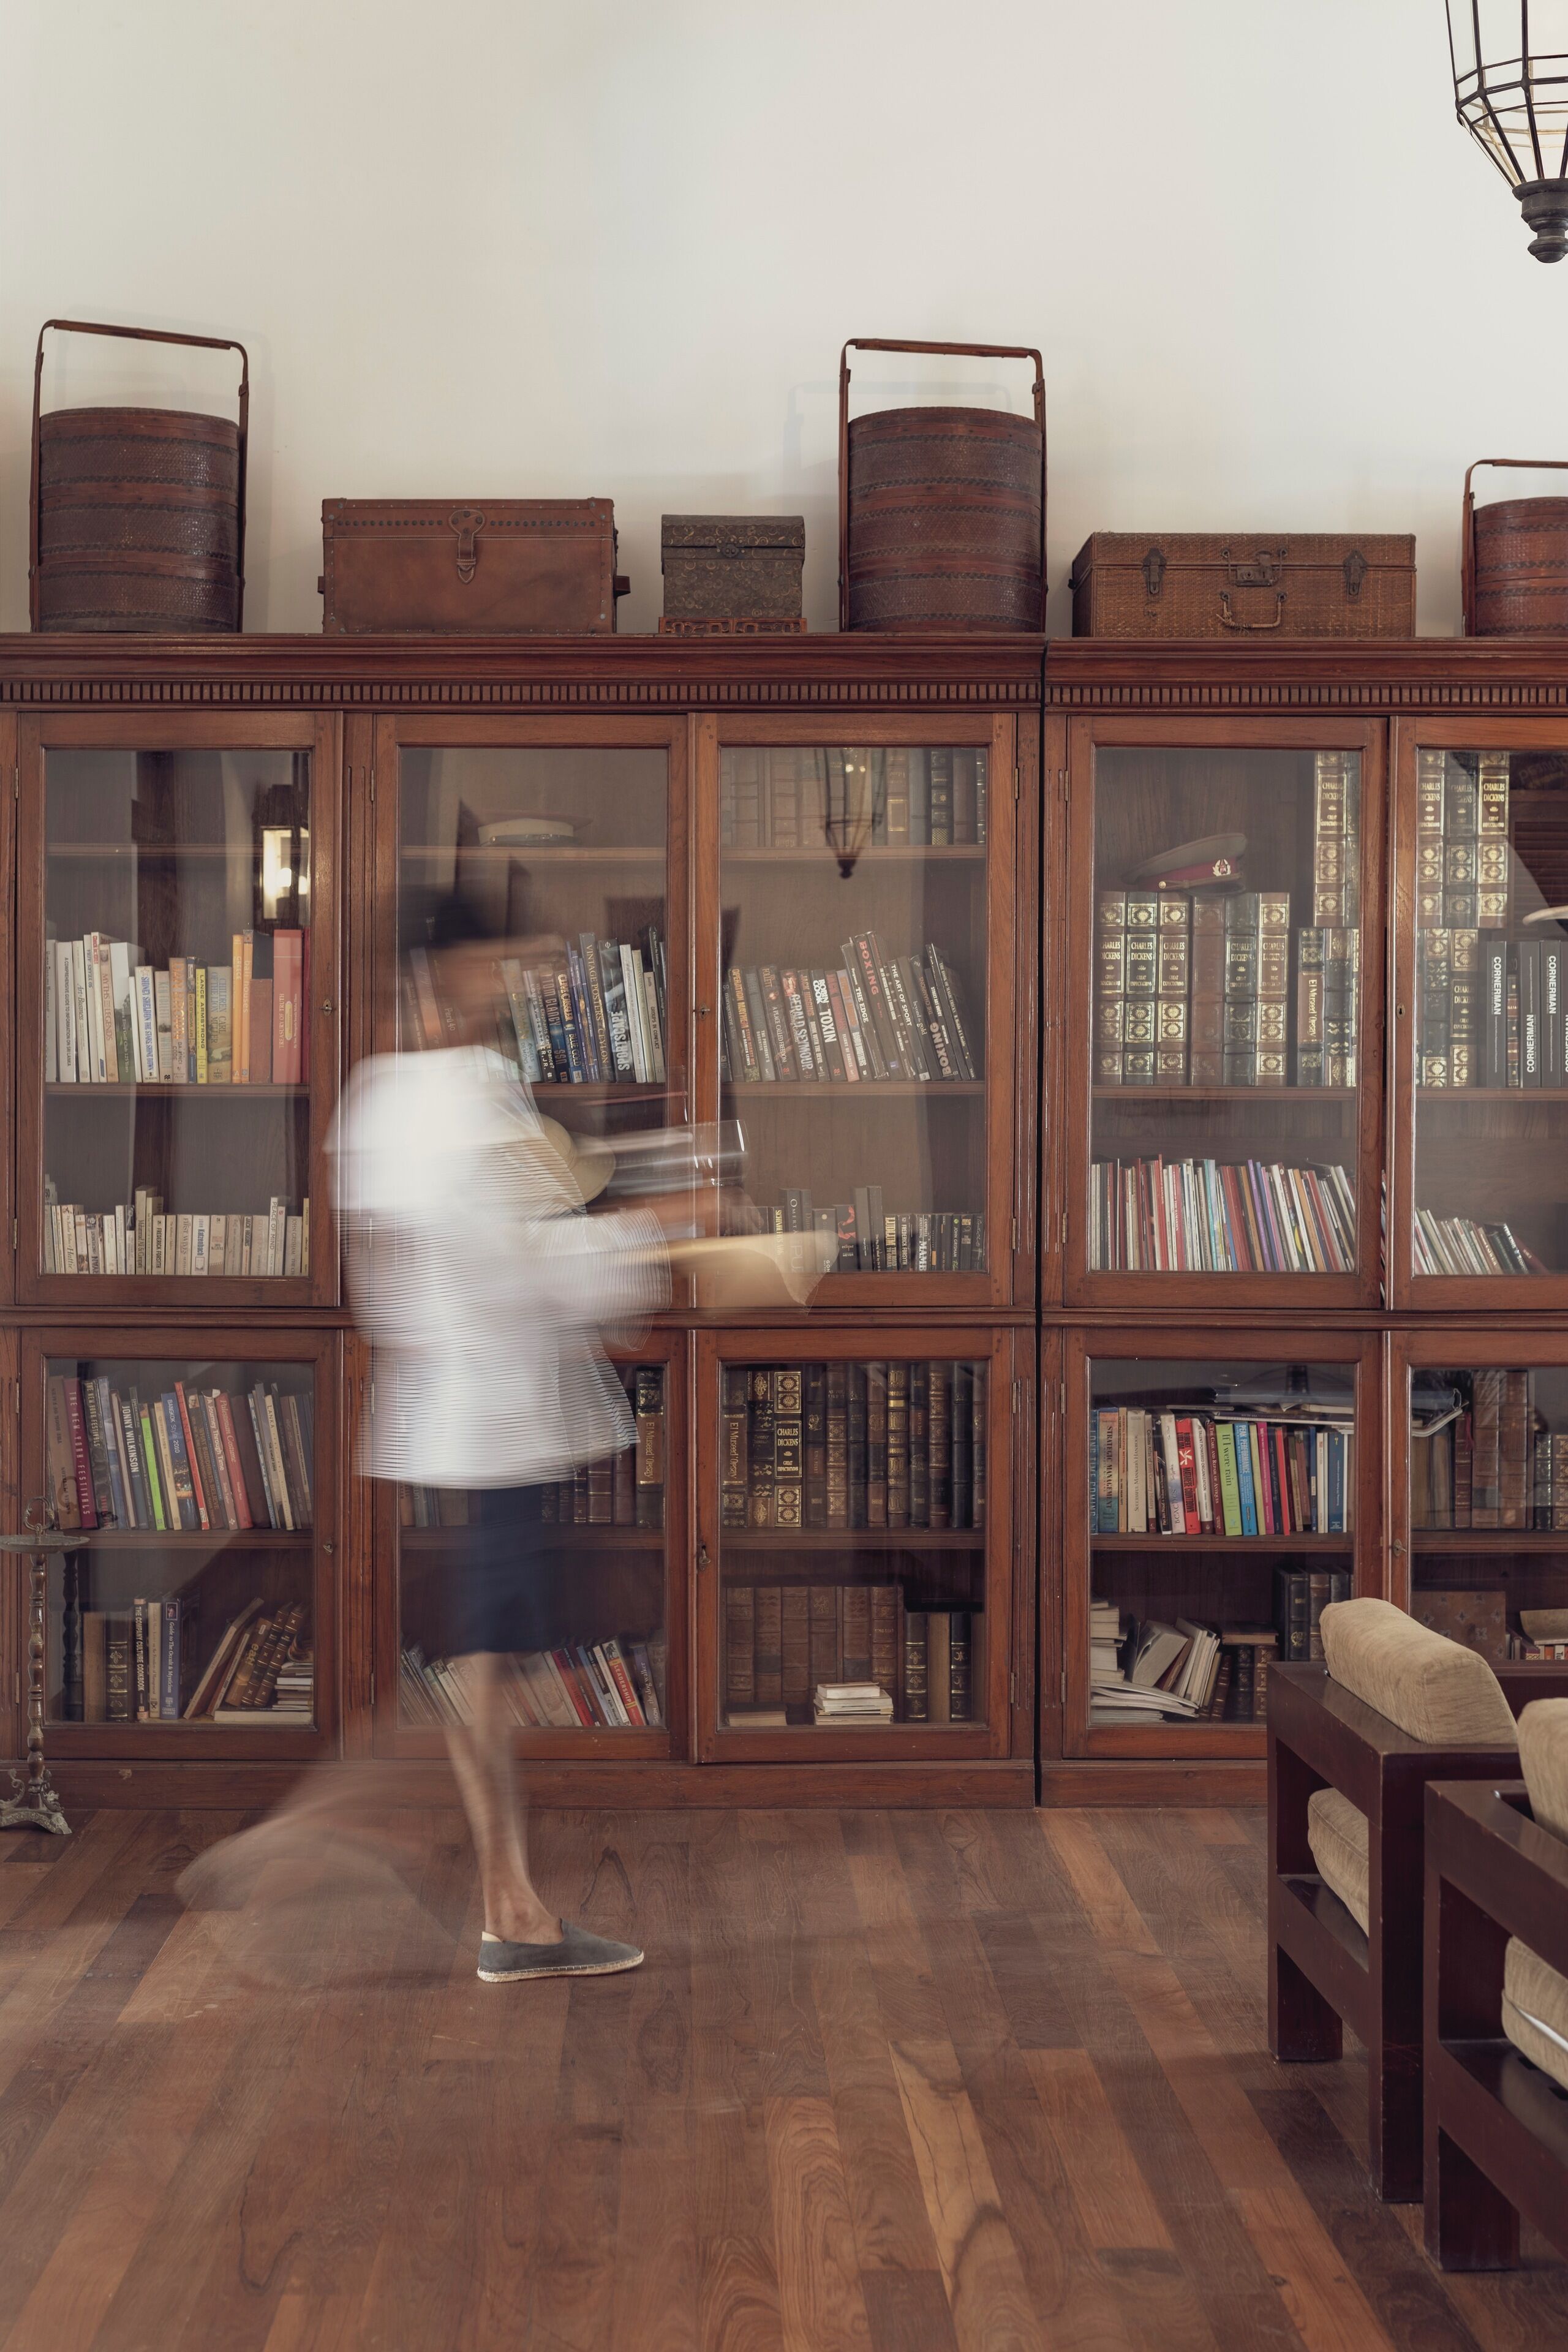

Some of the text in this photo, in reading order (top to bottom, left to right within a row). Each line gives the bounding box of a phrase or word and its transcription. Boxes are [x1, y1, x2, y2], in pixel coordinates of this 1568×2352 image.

[762, 968, 773, 987] FOLLETT
[859, 940, 880, 995] BOXING
[890, 964, 899, 978] THE
[102, 973, 110, 1000] MYTHS
[218, 978, 227, 1012] CHILDREN
[586, 944, 603, 1021] VINTAGE POSTERS
[800, 974, 815, 1016] JACK HIGGINS
[812, 979, 823, 1005] COOK
[818, 978, 830, 1003] ROBIN
[894, 979, 903, 993] ART
[142, 997, 151, 1021] SHELDON
[541, 979, 561, 1026] TOM CLANCY
[561, 993, 573, 1021] CUSSLER
[732, 968, 749, 1028] OPERATION MAYHEM
[855, 987, 869, 1023] THE EDGE
[898, 993, 905, 1003] OF
[104, 1008, 113, 1041] LEGENDS
[173, 991, 184, 1039] BROWN
[218, 1016, 227, 1033] CARL
[819, 1008, 837, 1043] TOXIN
[900, 1005, 912, 1027] SPORT
[610, 1011, 631, 1071] SPORTSCAPE
[775, 1024, 783, 1041] CALLED
[790, 993, 813, 1070] GERALD SEYMOUR
[1526, 1014, 1534, 1073] CORNERMAN
[554, 1049, 567, 1064] SSN
[568, 1034, 581, 1066] BLUE GOLD
[597, 1028, 609, 1064] CEYLON
[778, 1041, 787, 1063] FREEDOM
[929, 1022, 952, 1076] BOXING
[271, 1223, 276, 1232] OF
[885, 1216, 896, 1246] LUDLUM
[69, 1392, 77, 1406] THE
[167, 1399, 176, 1423] BANGKOK
[72, 1412, 80, 1429] NEW
[121, 1406, 133, 1428] JONNY
[208, 1405, 217, 1429] Journey
[266, 1404, 275, 1428] LANKA
[124, 1431, 140, 1473] WILKINSON
[212, 1430, 222, 1455] Through
[226, 1435, 237, 1463] Costume
[1224, 1447, 1232, 1466] were
[1240, 1439, 1251, 1474] PERFORMANCE
[77, 1464, 91, 1515] FESTIVALS
[1225, 1469, 1234, 1486] rain
[614, 1665, 631, 1703] LEADERSHIP
[640, 1662, 650, 1682] walker
